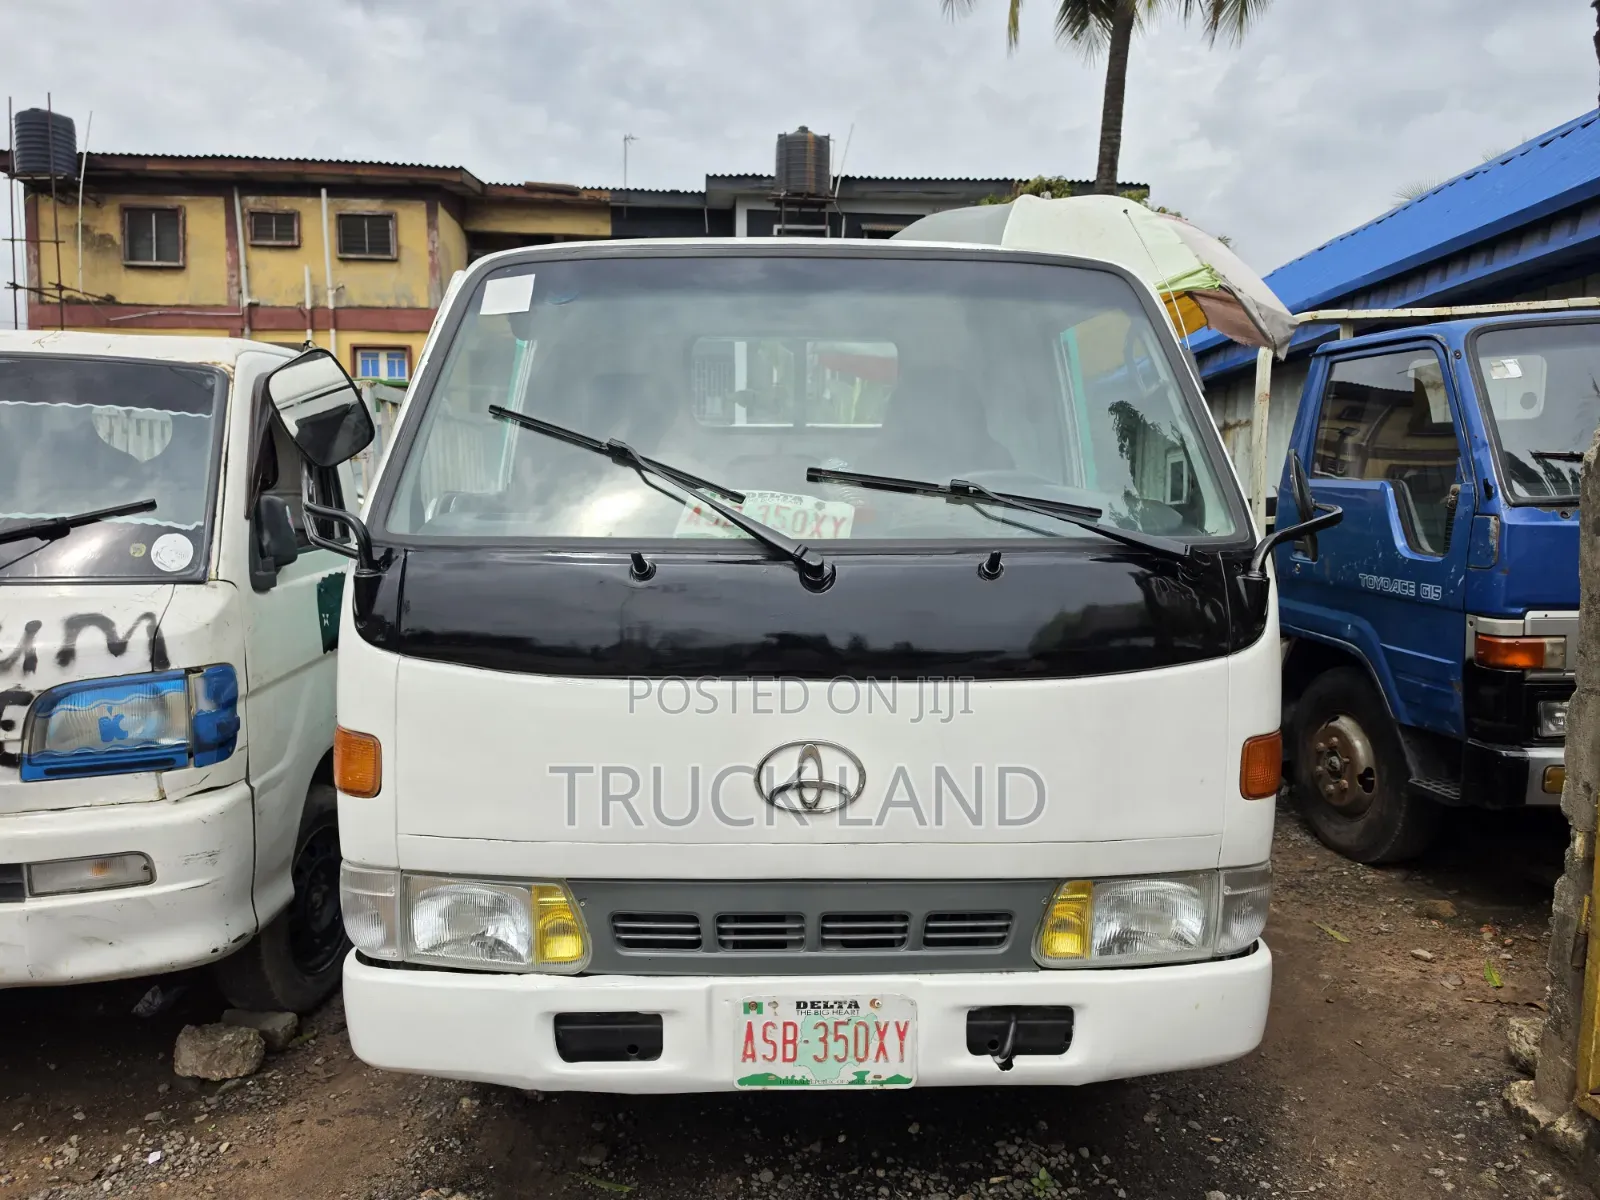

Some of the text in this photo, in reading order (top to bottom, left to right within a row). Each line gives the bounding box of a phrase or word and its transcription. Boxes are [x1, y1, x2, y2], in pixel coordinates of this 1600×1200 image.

[1359, 573, 1415, 596] TOYOACE
[795, 1000, 860, 1010] DELTA
[741, 1020, 911, 1063] ASB-350XY
